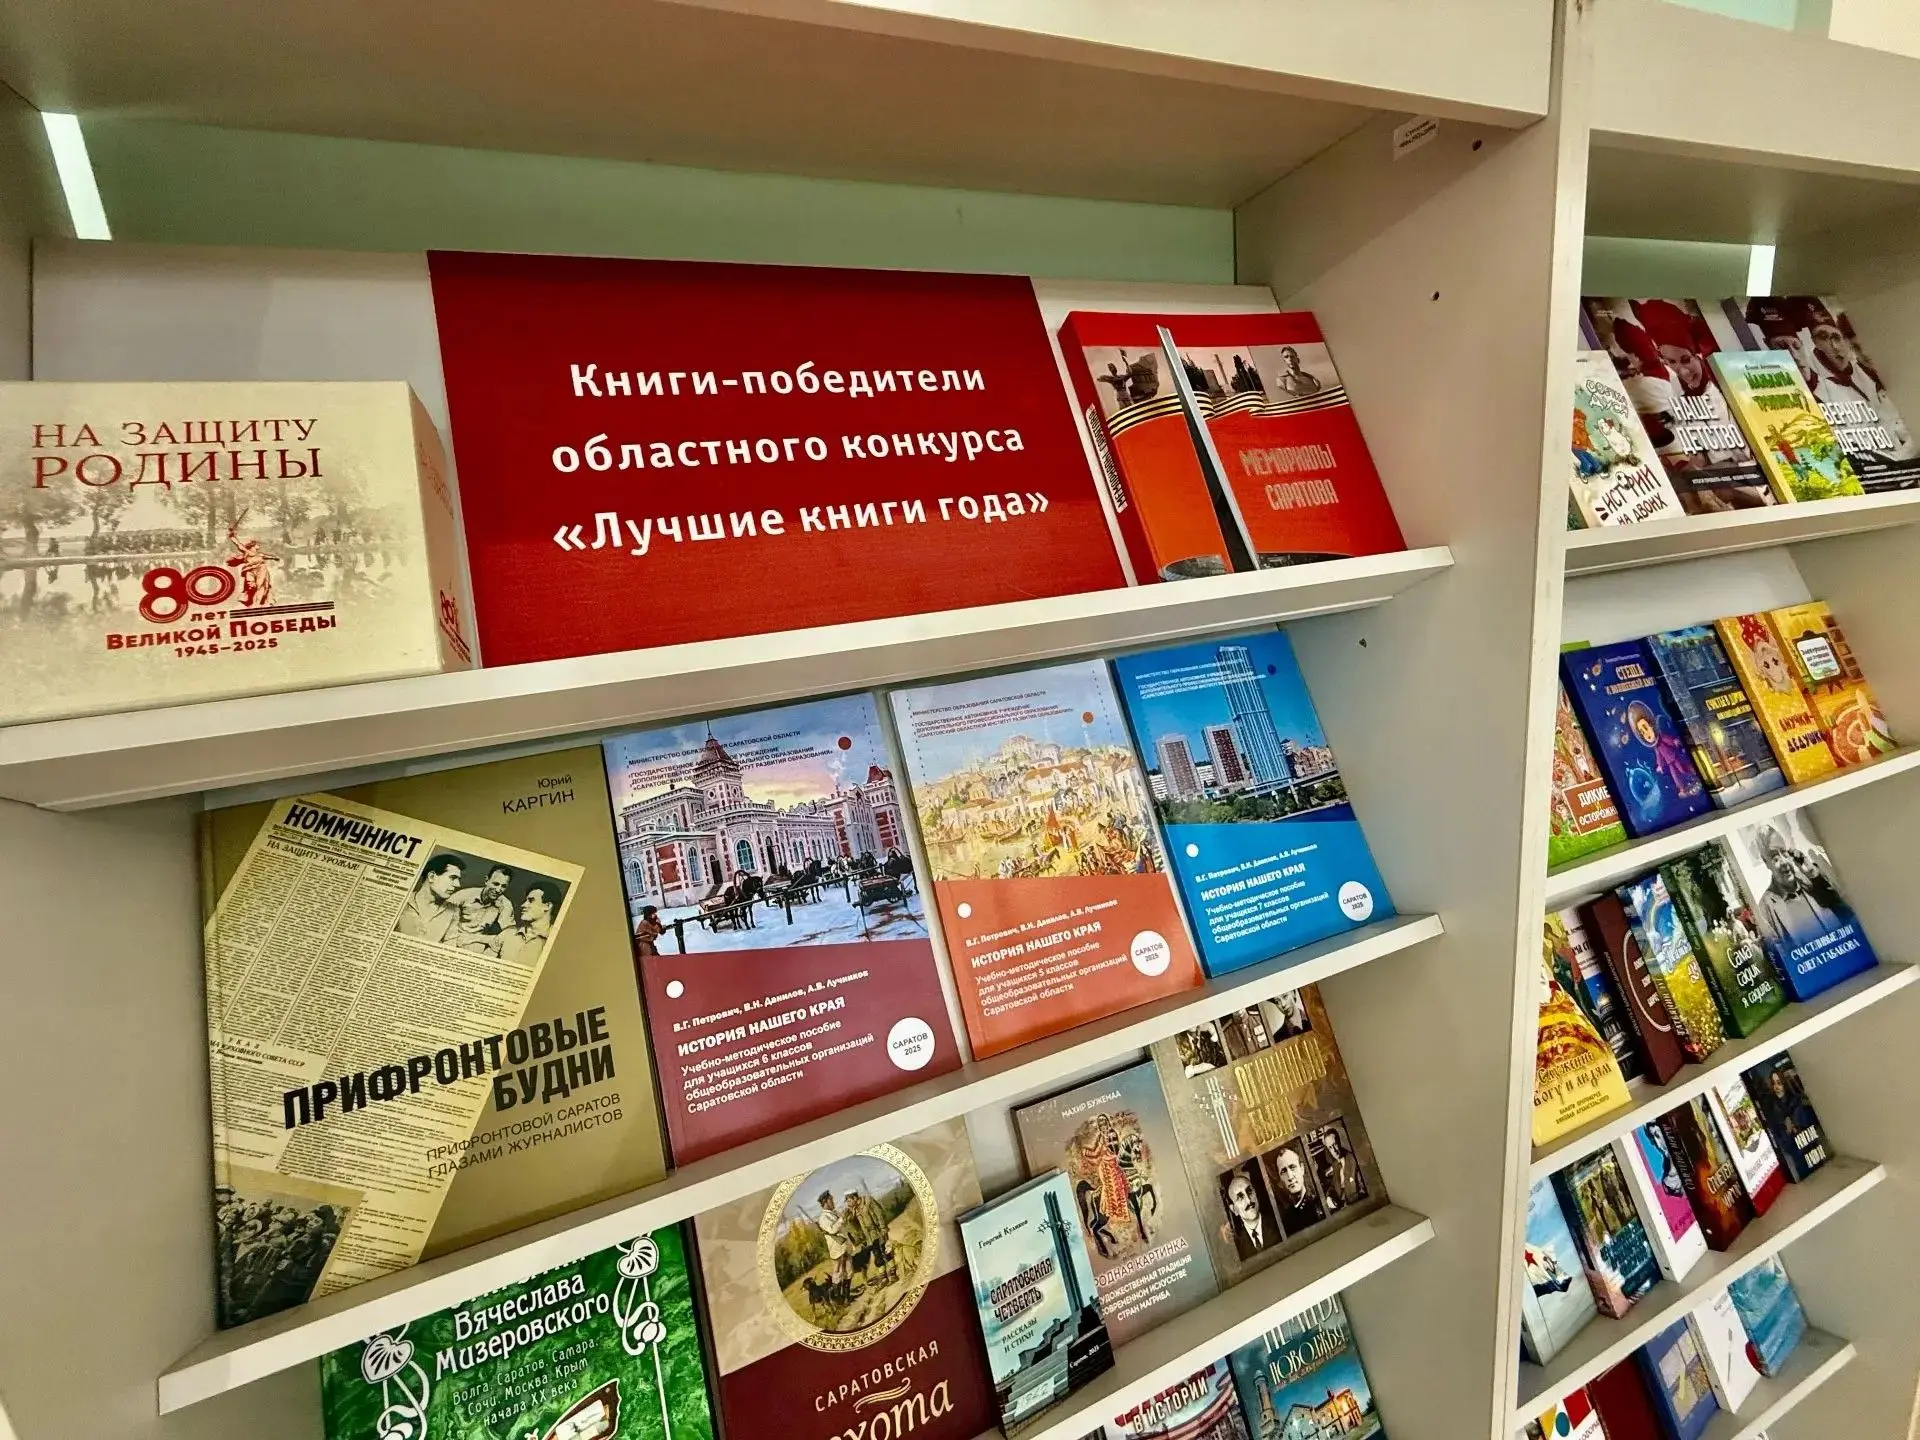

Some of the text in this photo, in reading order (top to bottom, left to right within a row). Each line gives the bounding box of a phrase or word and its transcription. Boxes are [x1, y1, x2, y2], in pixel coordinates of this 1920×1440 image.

[570, 362, 985, 397] Книги-победители
[1669, 395, 1718, 420] НАШЕ
[1818, 401, 1878, 425] ВЕРНУТЬ
[33, 418, 318, 449] НА ЗАЩИТУ
[552, 428, 1025, 473] областного конкурса
[1676, 424, 1744, 454] ДЕТСТВО
[1834, 426, 1893, 455] ДЕТСТВО
[32, 448, 324, 492] РОДИНЫ
[1239, 444, 1337, 476] МЕМОРИАЛЫ
[1264, 479, 1339, 511] САРАТОВА
[1632, 493, 1668, 522] ДВОИХ
[552, 491, 1049, 556] «Лучшие книги года»
[138, 565, 236, 624] 80 лет
[628, 731, 801, 765] МИНИСТЕРСТВО САРАТОВСКОЙ ОБЛАСТИ
[537, 774, 572, 789] Юрий
[502, 789, 575, 814] КАРГИН
[284, 804, 423, 859] КОММУНИСТ
[267, 840, 280, 850] НА
[282, 842, 321, 860] ЗАЩИТУ
[1201, 863, 1306, 901] ИСТОРИЯ НАШЕГО КРАЯ
[1342, 893, 1368, 905] САРАТОВ
[1210, 915, 1223, 926] для
[1215, 916, 1288, 944] Саратовской области
[971, 921, 1102, 968] ИСТОРИЯ НАШЕГО КРАЯ
[1135, 943, 1165, 956] САРАТОВ
[1727, 944, 1752, 968] Сама
[975, 941, 1100, 985] Учебно-методическое пособие
[978, 959, 1079, 996] для учащихся 5 классов
[981, 954, 1128, 1006] общеобразовательных организаций
[1736, 962, 1761, 986] садик
[673, 969, 869, 1032] В.Г. Петрович, В.Н. Данилов, А.В. Лучников
[983, 983, 1074, 1017] Саратовской области
[677, 996, 846, 1057] ИСТОРИЯ НАШЕГО КРАЯ
[892, 1032, 929, 1050] САРАТОВ
[681, 1019, 842, 1076] Учебно-методическое пособие
[904, 1044, 922, 1056] 2025
[283, 1006, 609, 1130] ПРИФРОНТОВЫЕ
[492, 1044, 616, 1112] БУДНИ
[683, 1041, 813, 1090] для учащихся 6 классов
[685, 1034, 874, 1101] общеобразовательных организаций
[687, 1070, 804, 1114] Саратовской области
[426, 1092, 621, 1163] ПРИФРОНТОВОЙ САРАТОВ
[1061, 1102, 1087, 1118] МАХИР
[428, 1108, 624, 1179] ГЛАЗАМИ ЖУРНАЛИСТОВ
[978, 1231, 1003, 1250] Георгий
[1094, 1237, 1188, 1287] РОДНАЯ КАРТИНКА
[1100, 1255, 1192, 1303] УДОЖЕСТВЕННАЯ ТРАДИЦИЯ
[990, 1257, 1053, 1305] САРАТОВСКАЯ
[1149, 1272, 1187, 1296] ИСКУССТВЕ
[454, 1273, 585, 1341] Вячеслава
[994, 1286, 1042, 1322] ЧЕТВЕРТЬ
[1117, 1290, 1170, 1321] СТРАН МАГРИБА
[436, 1293, 609, 1381] Мизеровского
[1002, 1317, 1037, 1344] РАССКАЗЫ
[1004, 1330, 1034, 1354] И СТИХИ
[497, 1361, 548, 1386] Саратов.
[555, 1358, 588, 1378] Крым
[815, 1340, 939, 1412] САРАТОВСКАЯ
[484, 1403, 526, 1426] начала
[551, 1378, 578, 1398] века
[1133, 1412, 1144, 1434] В
[1147, 1377, 1209, 1427] ИСТОРИИ
